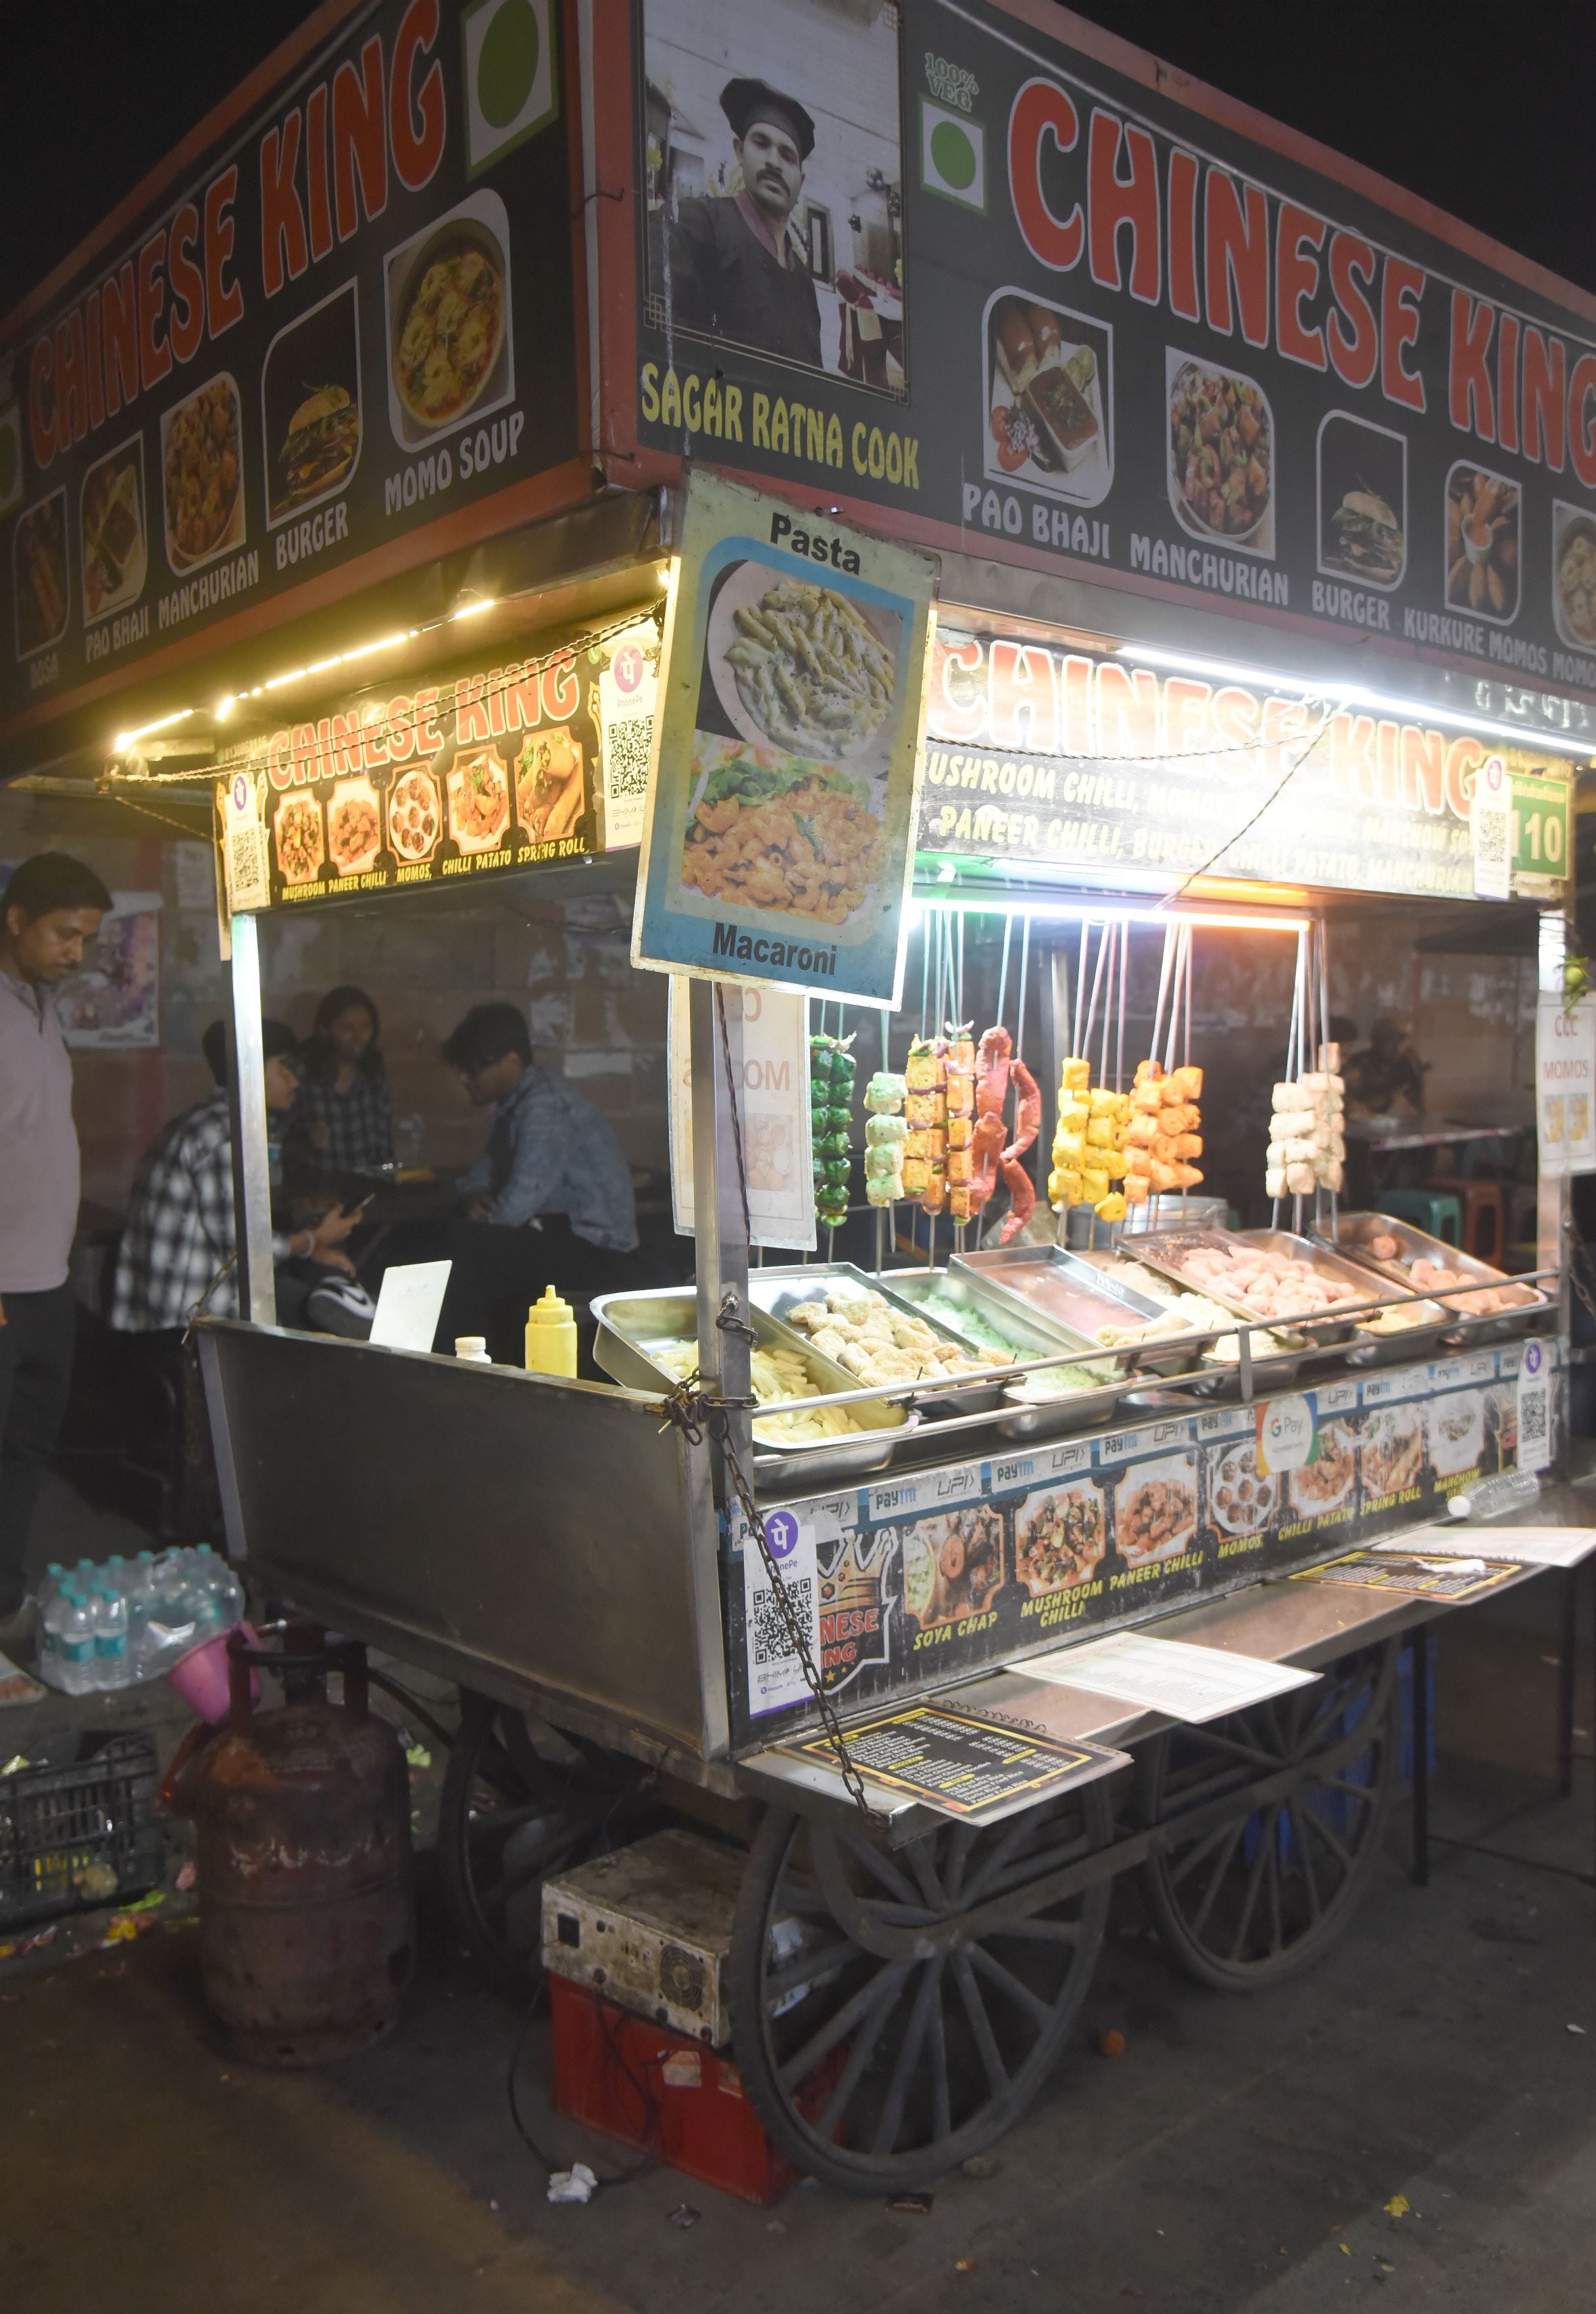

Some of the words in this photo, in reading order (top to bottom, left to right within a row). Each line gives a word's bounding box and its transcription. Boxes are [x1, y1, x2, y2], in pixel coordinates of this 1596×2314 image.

[924, 53, 979, 95] 100%
[928, 75, 973, 112] VEG
[29, 164, 244, 469] CHINESE
[261, 0, 446, 299] KING
[1007, 76, 1428, 414] CHINESE
[642, 362, 743, 443] SAGAR
[753, 392, 843, 469] RATNA
[851, 422, 920, 490] COOK
[384, 454, 453, 516] MOMO
[459, 411, 525, 481] SOUP
[276, 501, 349, 570] BURGER
[962, 483, 1023, 535] PAO
[1032, 504, 1111, 560] BHAJI
[769, 512, 861, 576] Pasta
[158, 550, 259, 629] MANCHURIAN
[1130, 533, 1289, 607] MANCHURIAN
[1312, 581, 1389, 631] BURGER
[86, 629, 110, 662] PAO
[1404, 607, 1485, 654] KURKURE
[1489, 633, 1547, 674] MOMOS
[266, 687, 445, 791] CHINESE
[455, 649, 581, 745] KING
[617, 695, 643, 708] PhonePe
[928, 639, 1310, 785] CHINESE
[1329, 714, 1482, 819] KING
[926, 752, 1057, 800] USHROOM
[1064, 772, 1139, 814] CHILLI,
[940, 805, 1040, 846] PANEER
[1047, 818, 1125, 859] CHILLI,
[443, 856, 471, 875] CHILLI
[476, 848, 512, 870] PATATO
[517, 842, 555, 863] SPRING
[282, 881, 325, 901] MUSHROOM
[328, 876, 359, 893] PANEER
[361, 870, 386, 889] CHILLI
[397, 863, 432, 883] MOMOS,
[712, 922, 837, 976] Macaroni
[1555, 1015, 1578, 1037] CCC
[1543, 1060, 1588, 1080] MOMOS
[1285, 1417, 1303, 1435] Pay
[1052, 1448, 1080, 1468] UPI
[937, 1475, 968, 1496] UPI
[1360, 1494, 1395, 1516] SPRING
[1398, 1485, 1422, 1505] ROLL
[1278, 1520, 1313, 1542] CHILLI
[1109, 1563, 1161, 1590] PANEER
[1163, 1550, 1205, 1575] CHILLI
[1020, 1579, 1103, 1618] MUSHROOM
[1039, 1601, 1086, 1628] CHILLI
[913, 1625, 952, 1650] SOYA
[957, 1612, 997, 1636] CHAP
